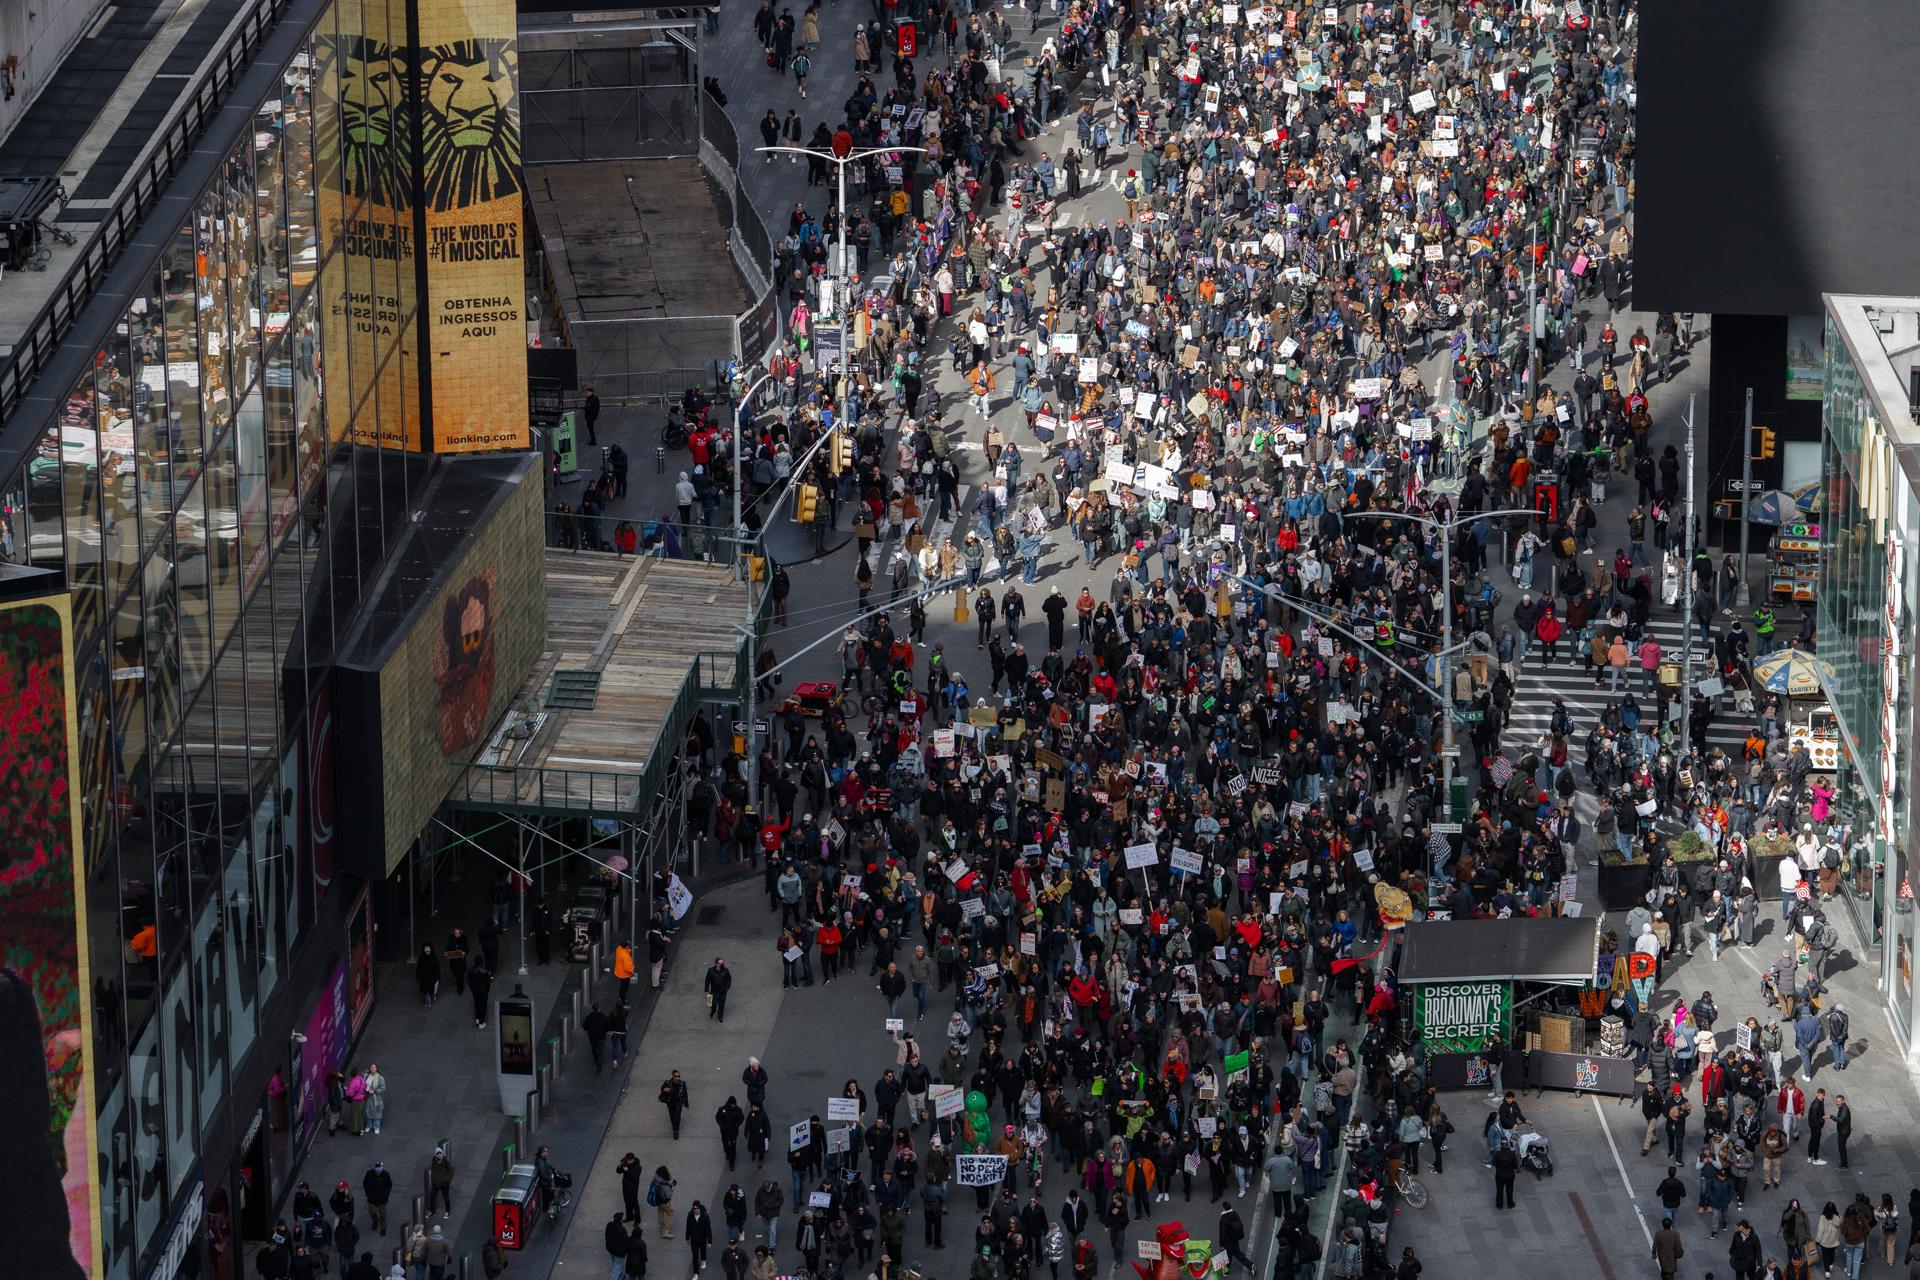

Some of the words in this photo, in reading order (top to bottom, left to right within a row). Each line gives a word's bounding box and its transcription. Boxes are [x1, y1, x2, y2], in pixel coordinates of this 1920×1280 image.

[431, 226, 456, 243] THE
[457, 222, 518, 241] WORLD'S
[429, 241, 447, 263] #1
[449, 239, 520, 262] MUSICAL
[444, 296, 512, 310] OBTENHA
[439, 311, 518, 325] INGRESSOS
[461, 326, 496, 338] AQUI
[446, 432, 517, 444] lionking.com
[1468, 712, 1476, 720] 45
[1250, 766, 1267, 784] NO
[575, 928, 589, 943] 15
[172, 778, 295, 1142] NEWS
[1425, 984, 1502, 997] DISCOVER
[1424, 994, 1502, 1027] BROADWAY'S
[1424, 1023, 1500, 1039] SECRETS
[796, 1123, 807, 1134] NO
[960, 1157, 975, 1165] NO
[979, 1156, 1006, 1166] WAR
[960, 1165, 976, 1174] NO
[960, 1173, 976, 1183] NO
[976, 1170, 1004, 1184] GRIFT
[502, 1231, 514, 1240] MJ
